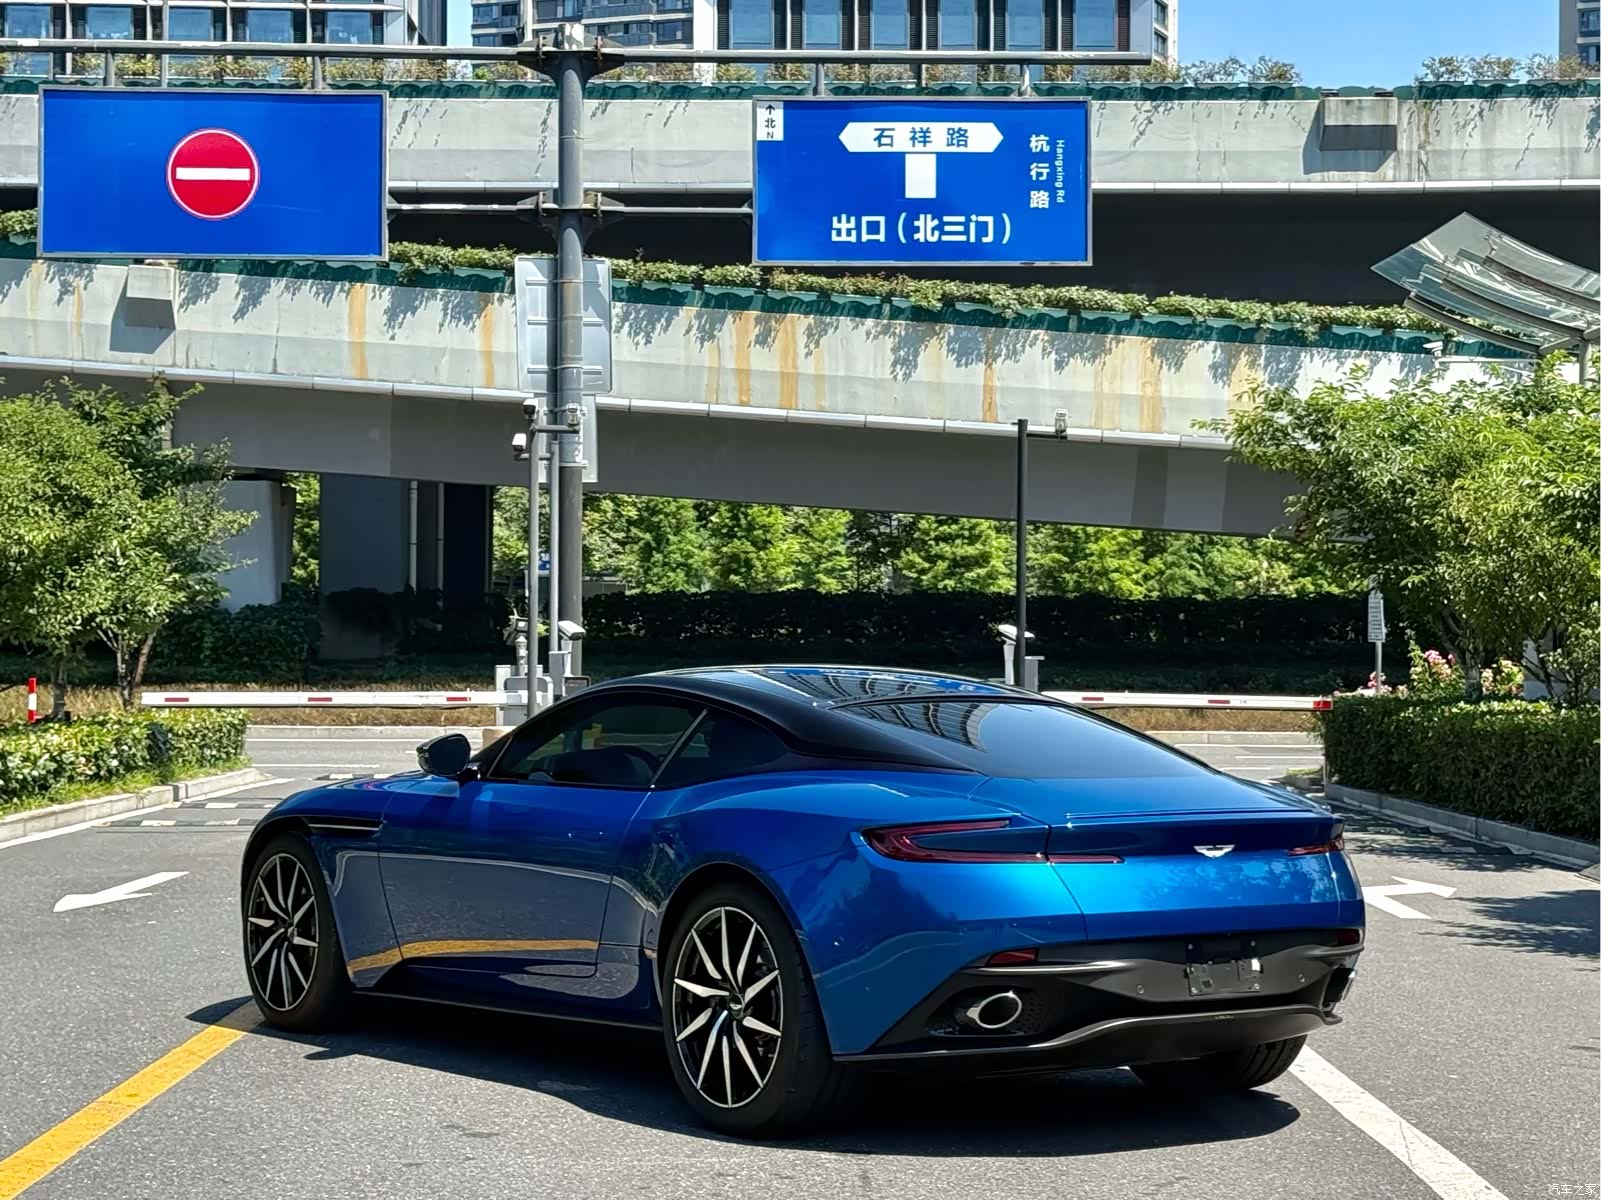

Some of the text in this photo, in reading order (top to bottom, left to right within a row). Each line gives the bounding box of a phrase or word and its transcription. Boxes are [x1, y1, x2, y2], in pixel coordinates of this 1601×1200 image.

[764, 117, 776, 129] 北
[766, 131, 774, 139] N
[873, 127, 969, 148] 石祥路
[1029, 134, 1050, 209] 杭行路
[1054, 139, 1066, 203] Hangxing Rd
